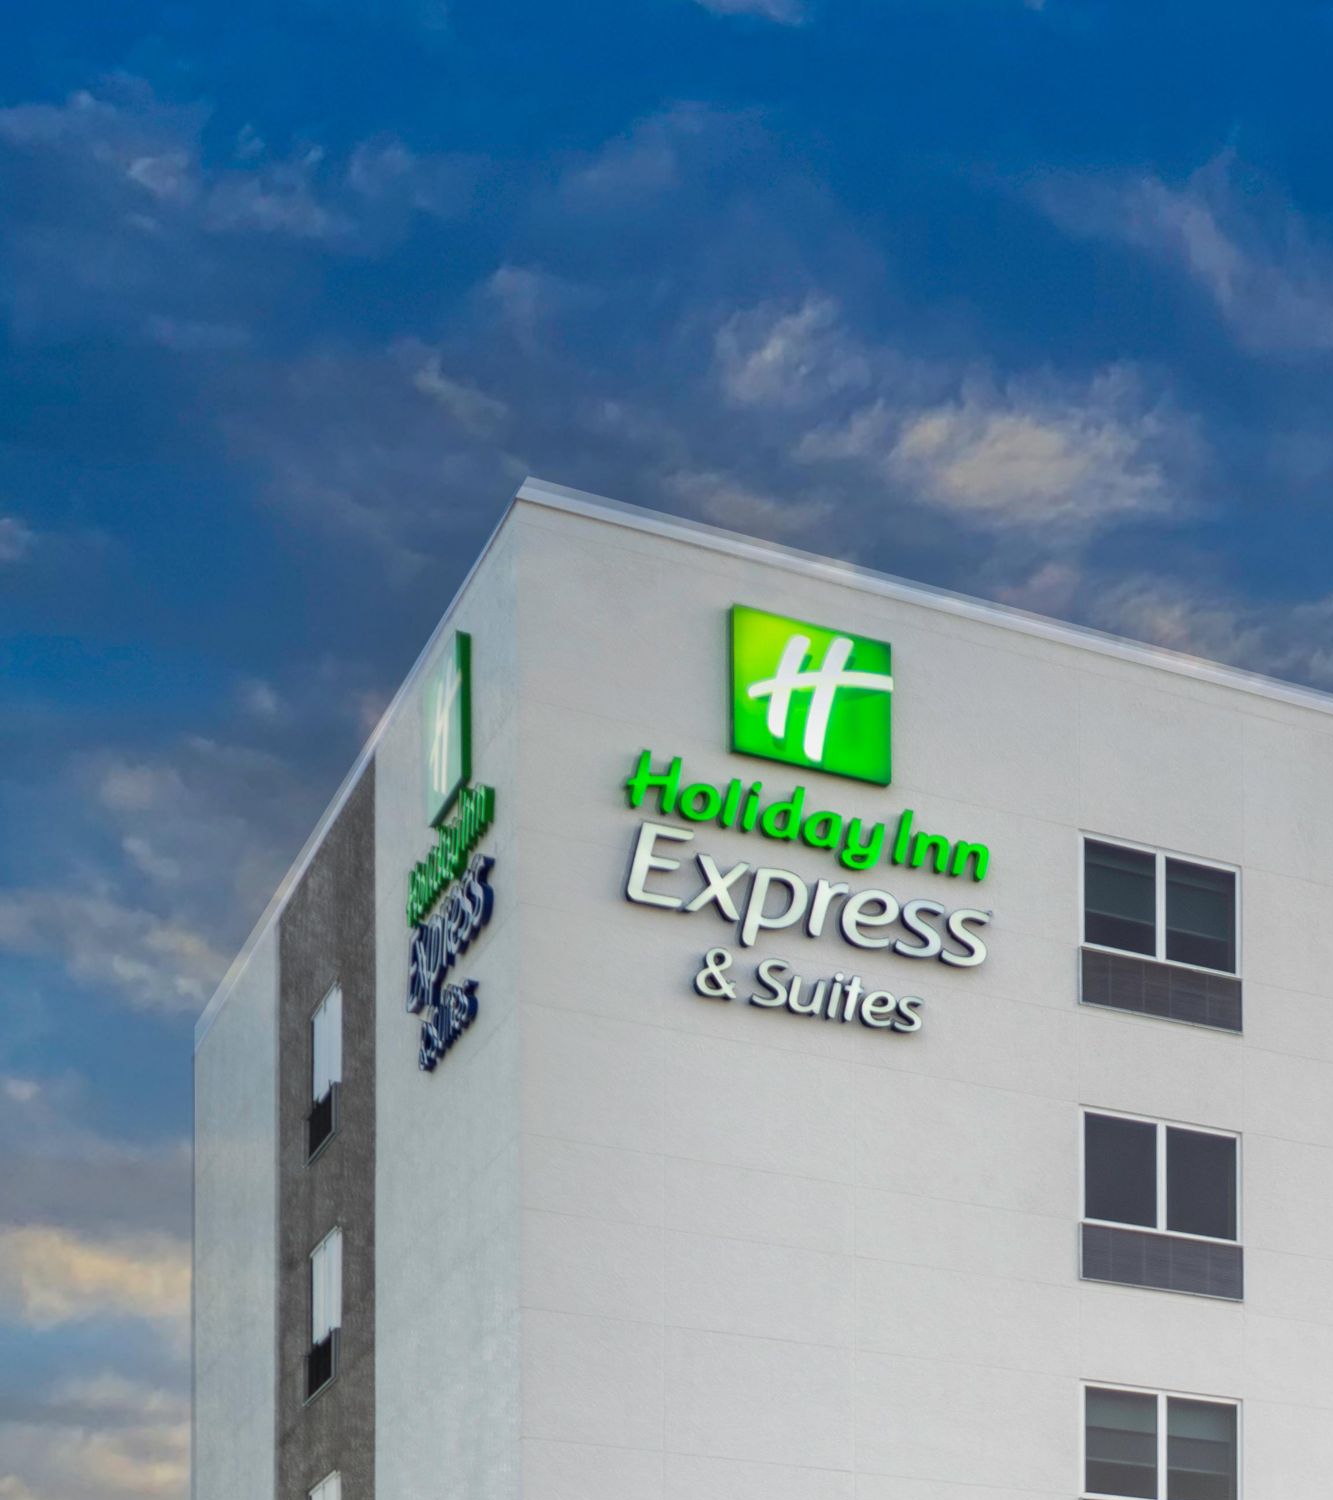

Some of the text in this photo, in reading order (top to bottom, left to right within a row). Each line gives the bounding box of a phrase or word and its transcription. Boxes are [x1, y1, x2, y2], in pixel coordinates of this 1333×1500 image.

[747, 634, 894, 762] H
[625, 749, 991, 883] Holiday Inn
[624, 820, 992, 968] Express
[693, 946, 924, 1034] & Suites
